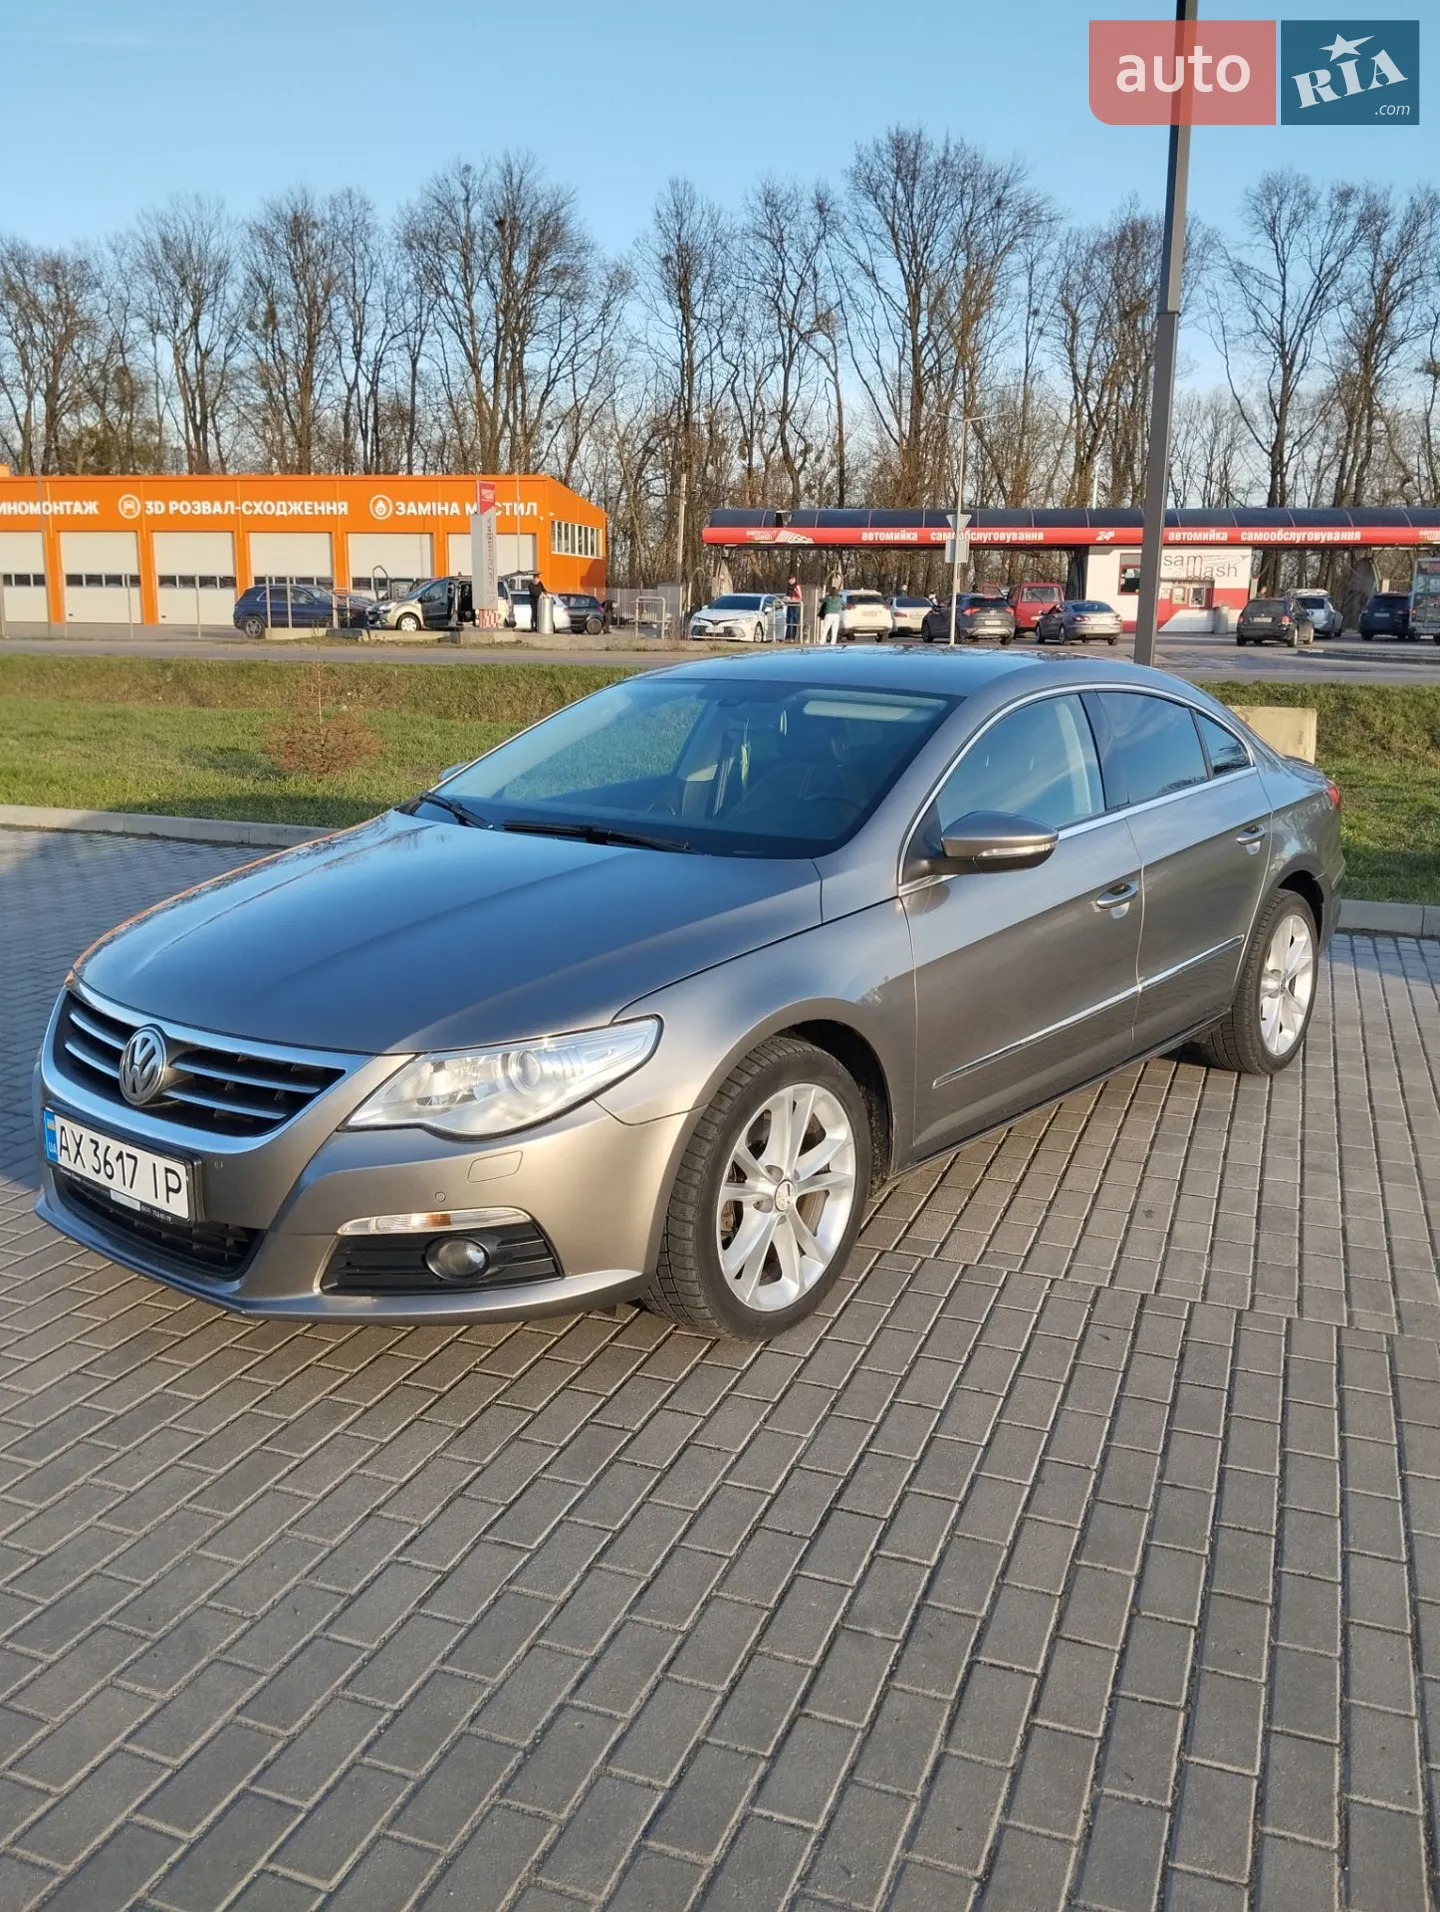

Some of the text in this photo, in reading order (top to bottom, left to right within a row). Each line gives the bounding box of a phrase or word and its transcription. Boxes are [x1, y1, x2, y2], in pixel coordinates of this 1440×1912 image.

[145, 500, 348, 516] 3D РОЗВАЛ-СХОДЖЕННЯ
[395, 501, 537, 516] ЗАМІНА МСТИЛ
[861, 529, 918, 541] автомийка
[1168, 528, 1361, 543] автомийка самообслуговування
[59, 1125, 182, 1204] AX 3617 IP
